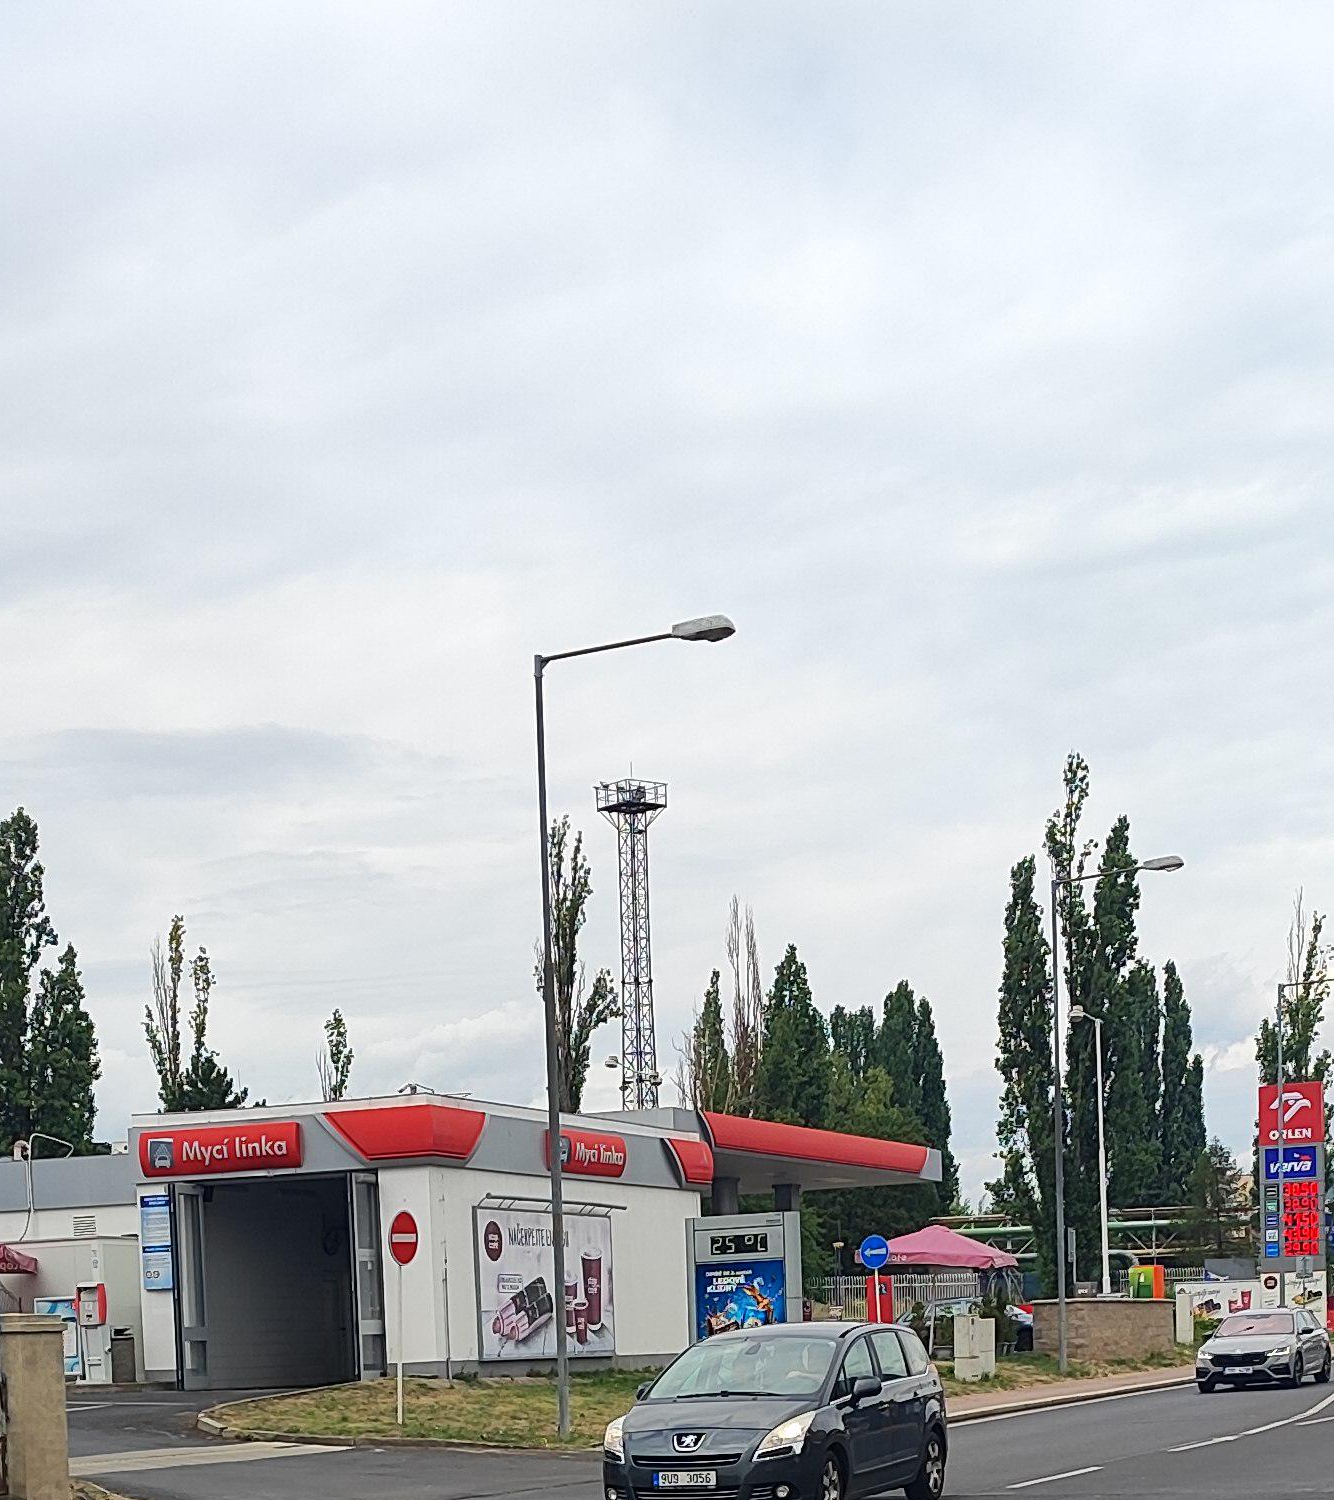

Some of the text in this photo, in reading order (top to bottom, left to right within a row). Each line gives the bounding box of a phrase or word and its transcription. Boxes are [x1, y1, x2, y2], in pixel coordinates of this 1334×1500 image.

[1269, 1127, 1312, 1141] ORLEN
[182, 1134, 288, 1167] Mycí linka
[712, 1236, 736, 1254] 25
